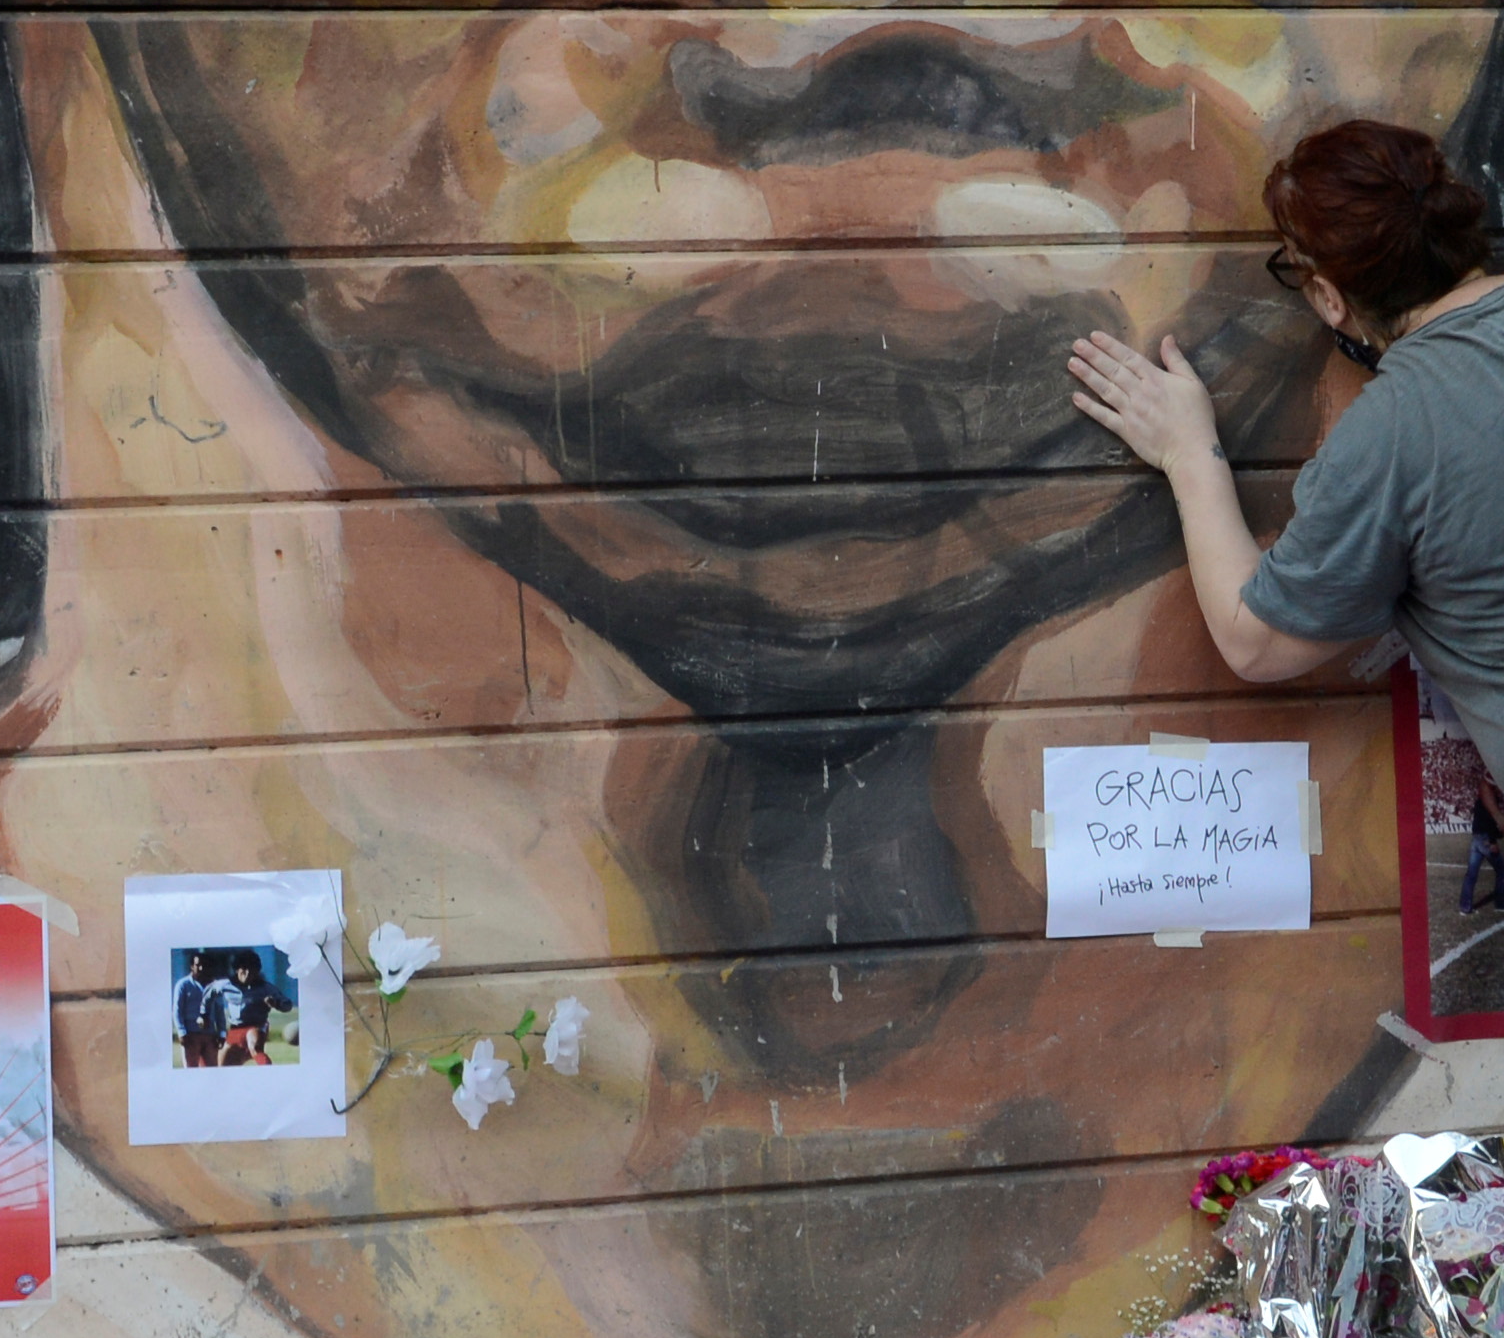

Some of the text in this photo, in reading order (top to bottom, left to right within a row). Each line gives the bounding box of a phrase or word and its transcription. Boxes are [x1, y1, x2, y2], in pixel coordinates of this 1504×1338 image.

[1095, 764, 1253, 813] GRACIAS
[1087, 822, 1279, 864] POR LA MAGIA
